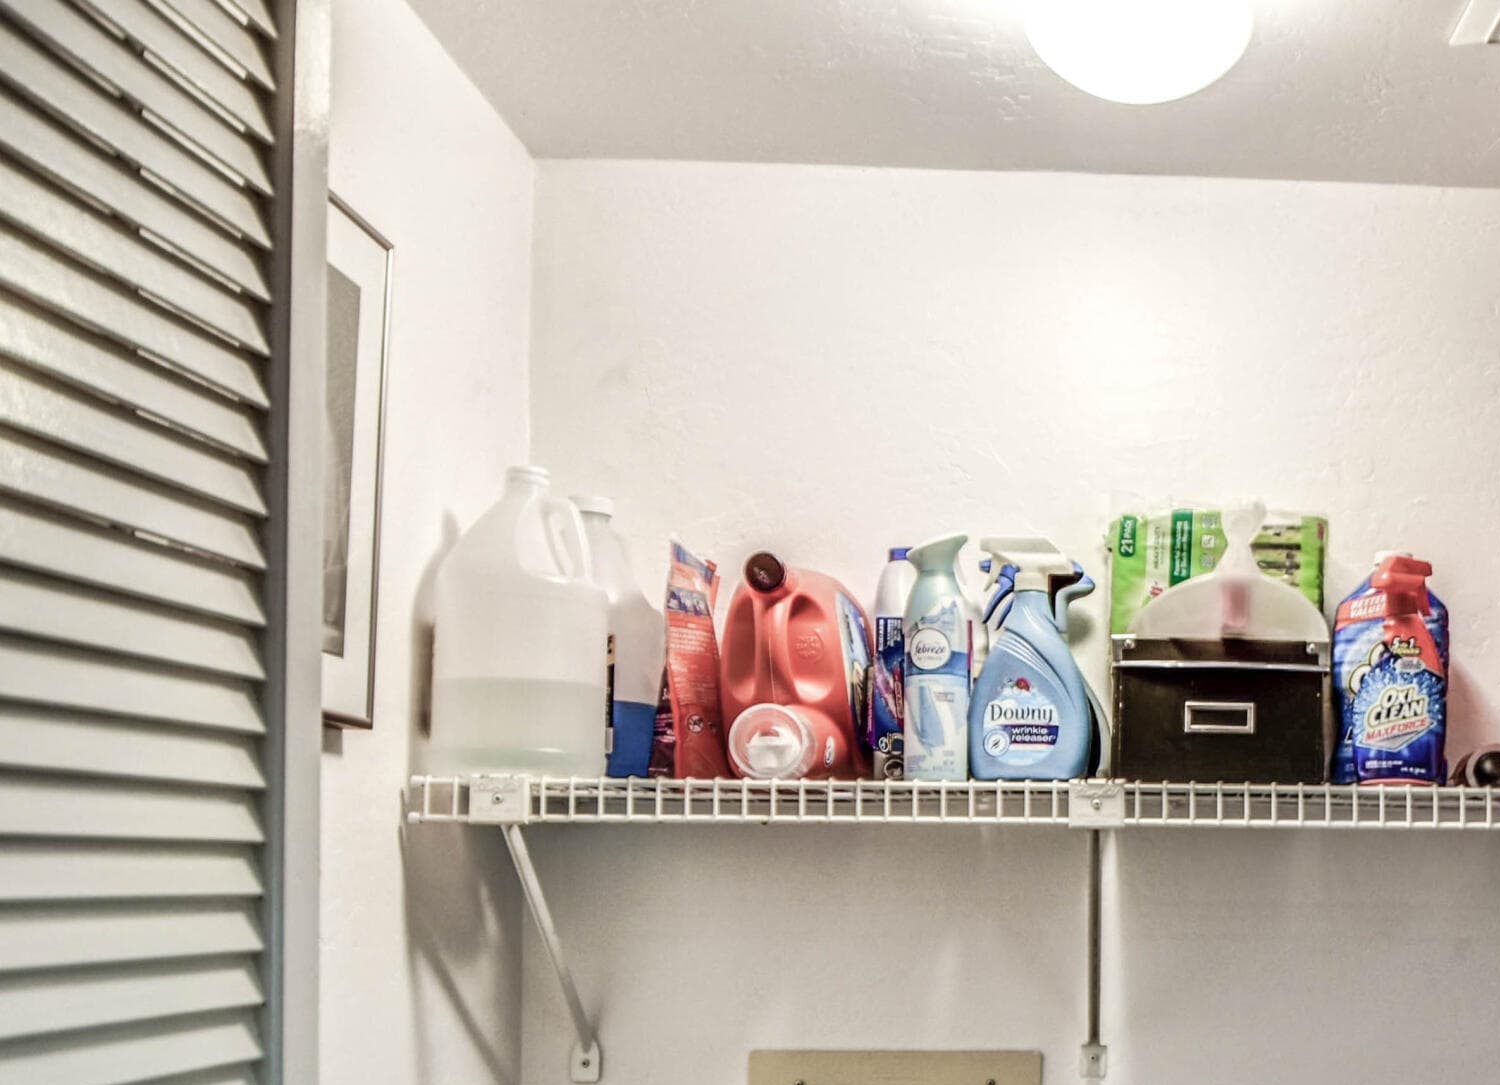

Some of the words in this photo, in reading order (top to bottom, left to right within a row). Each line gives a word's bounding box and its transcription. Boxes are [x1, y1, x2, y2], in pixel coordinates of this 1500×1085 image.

[1120, 538, 1134, 554] 21
[1381, 685, 1416, 707] OXI
[990, 703, 1053, 724] Downy
[1367, 697, 1426, 727] CLEAN
[1011, 726, 1048, 735] wrinkle
